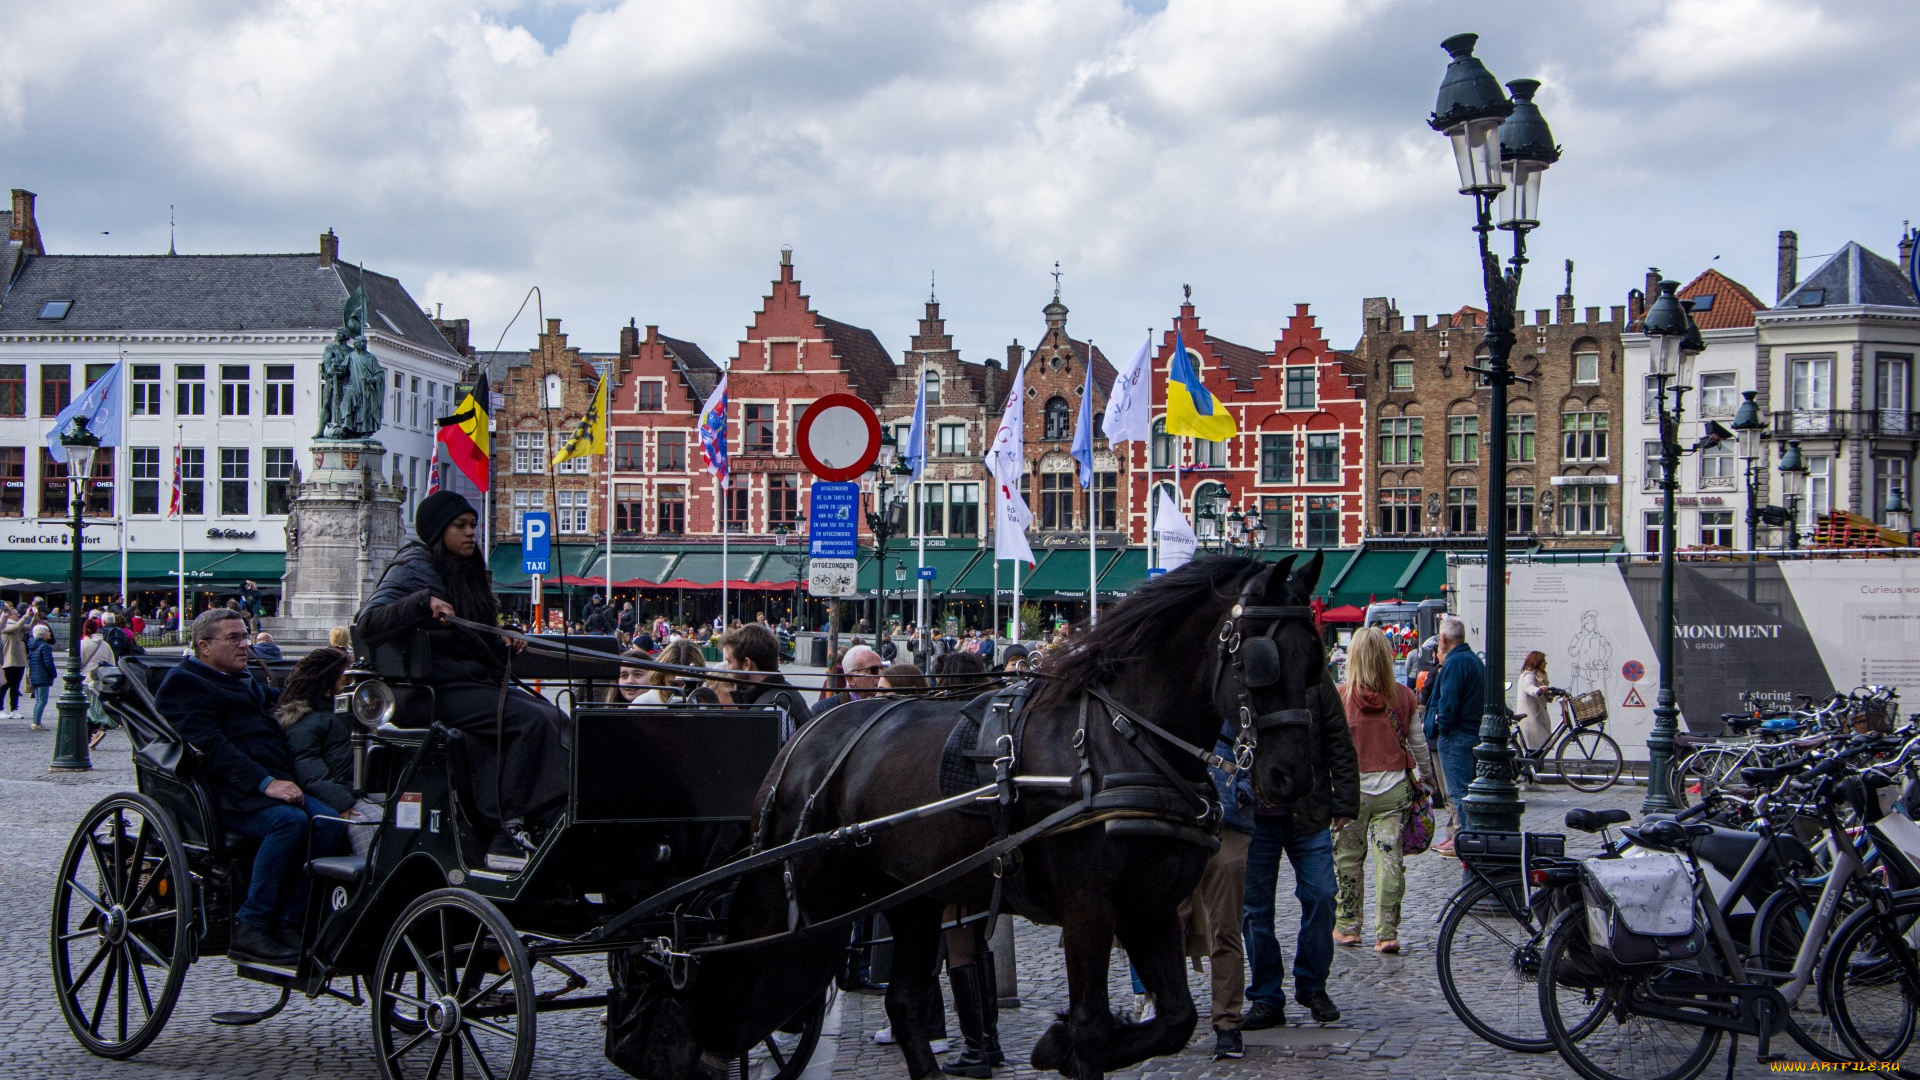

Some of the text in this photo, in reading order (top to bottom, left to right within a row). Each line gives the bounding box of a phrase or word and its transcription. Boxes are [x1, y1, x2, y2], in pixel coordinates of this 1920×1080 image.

[735, 460, 799, 470] LE PANIER
[8, 535, 36, 544] Grand
[38, 535, 59, 544] Café
[526, 519, 546, 551] P
[1043, 535, 1068, 547] Central
[525, 561, 546, 571] TAXI
[1861, 585, 1903, 594] Curieus
[1674, 625, 1782, 639] MONUMENT
[1739, 690, 1792, 702] rstoring
